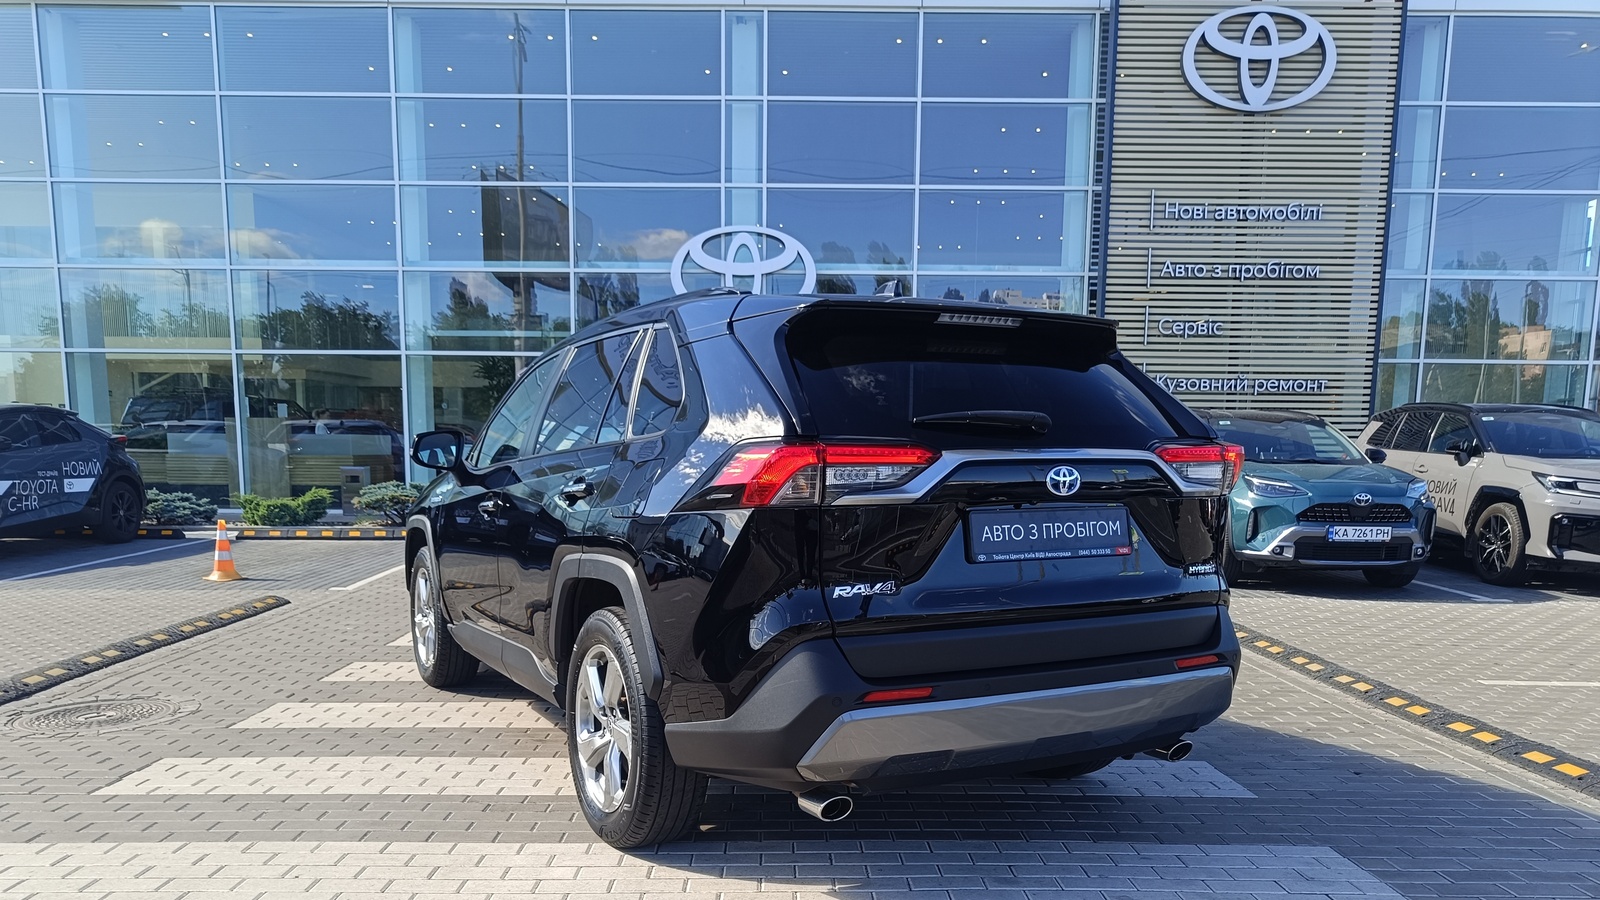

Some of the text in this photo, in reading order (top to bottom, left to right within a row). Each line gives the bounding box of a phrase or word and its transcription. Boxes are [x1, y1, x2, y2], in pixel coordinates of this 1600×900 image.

[1164, 201, 1324, 221] Нові автомобілі
[1160, 259, 1321, 282] Авто з пробігом
[1158, 318, 1224, 339] Сервіс
[1155, 373, 1329, 396] Кузовний ремонт
[61, 458, 103, 476] НОВИЙ
[14, 479, 59, 495] TOYOTA
[1427, 478, 1458, 496] ОВИЙ
[8, 495, 40, 512] C-HR
[981, 520, 1122, 542] АВТО З ПРОБІГОМ
[1352, 528, 1374, 538] 7261
[833, 580, 896, 599] RAV4
